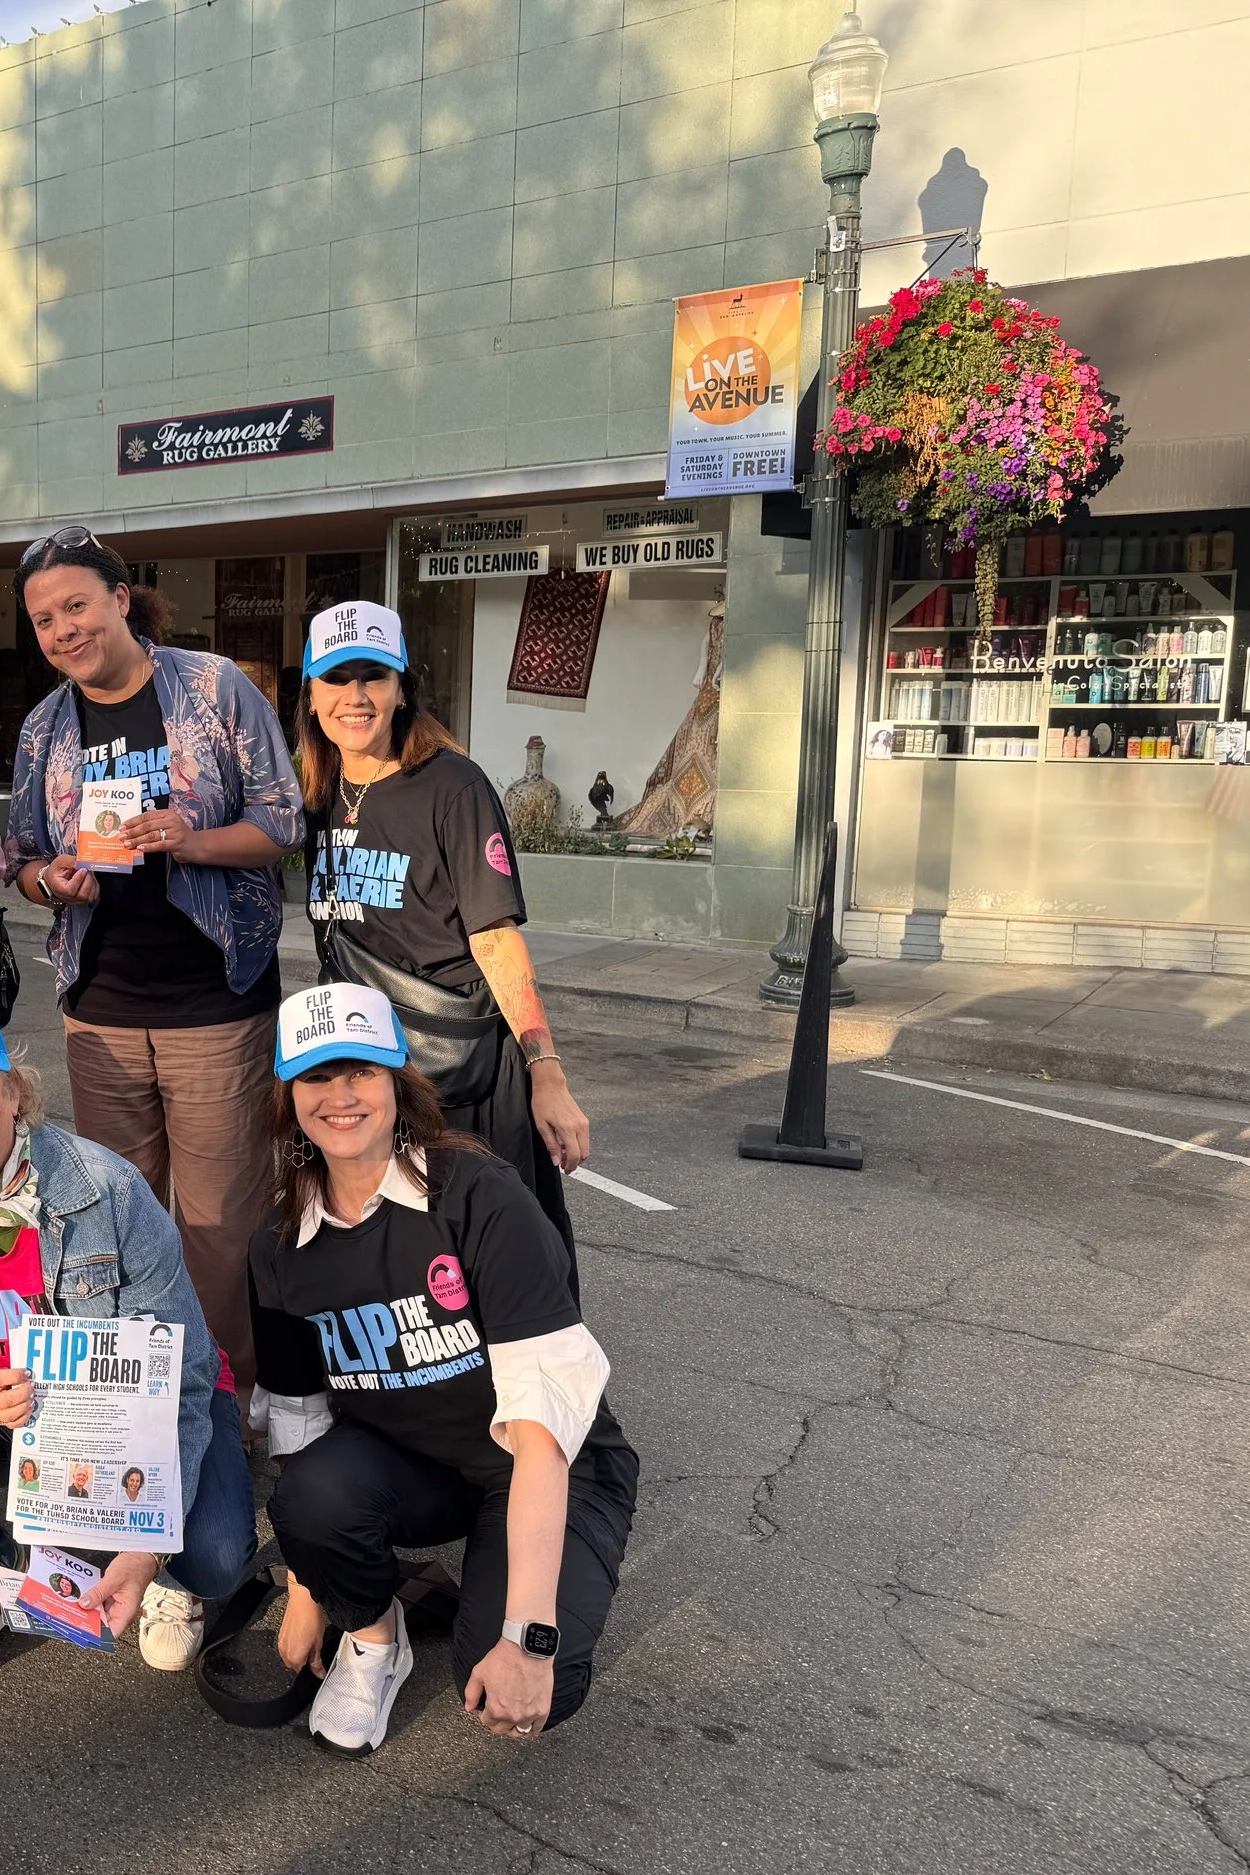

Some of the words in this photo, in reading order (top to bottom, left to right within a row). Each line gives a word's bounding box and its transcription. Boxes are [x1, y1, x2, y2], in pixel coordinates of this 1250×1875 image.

[704, 376, 731, 393] ON
[734, 375, 758, 387] THE
[688, 384, 784, 412] AVENUE
[152, 408, 293, 450] Fairmont
[162, 447, 199, 464] RUG
[202, 437, 281, 460] GALLERY
[685, 455, 716, 464] FRIDAY
[733, 449, 786, 460] DOWNTOWN
[680, 463, 724, 473] SATURDAY
[682, 471, 723, 482] EVENINGS
[732, 457, 785, 478] FREE!
[446, 518, 522, 542] HANDWASH
[584, 545, 607, 567] WE
[612, 542, 642, 565] BUY
[645, 540, 671, 562] OLD
[675, 537, 715, 559] RUGS
[428, 557, 459, 576] RUG
[464, 551, 539, 573] CLEANING
[335, 608, 357, 622] FLIP
[337, 619, 357, 632] THE
[324, 630, 358, 649] BOARD
[1113, 639, 1191, 672] Salon
[81, 744, 109, 764] OTE
[111, 737, 127, 758] IN
[89, 789, 109, 798] JOY
[111, 790, 134, 800] KOO
[310, 876, 321, 901] &
[306, 991, 332, 1010] FLIP
[309, 1006, 334, 1023] THE
[296, 1020, 335, 1045] BOARD
[432, 1282, 455, 1291] Friends
[435, 1292, 448, 1300] Tam
[28, 1317, 46, 1327] VOTE
[46, 1318, 60, 1328] OUT
[62, 1318, 75, 1329] THE
[76, 1319, 120, 1331] INCUMBENTS
[389, 1295, 434, 1332] THE
[304, 1302, 398, 1374] FLIP
[400, 1318, 481, 1368] BOARD
[26, 1329, 88, 1382] FLIP
[92, 1331, 119, 1356] THE
[89, 1357, 142, 1385] BOARD
[329, 1374, 359, 1390] VOTE
[357, 1373, 381, 1390] OUT
[379, 1372, 404, 1390] THE
[405, 1351, 485, 1387] INCUMBENTS
[53, 1383, 64, 1391] HIGH
[66, 1384, 88, 1392] SCHOOLS
[89, 1384, 99, 1392] FOR
[100, 1385, 116, 1393] EVERY
[117, 1385, 140, 1394] STUDENT.
[147, 1380, 163, 1388] LEARN
[16, 1505, 30, 1513] FOR
[32, 1507, 45, 1516] THE
[46, 1509, 69, 1520] TUHSD
[71, 1513, 99, 1523] SCHOOL
[101, 1515, 125, 1525] BOARD
[17, 1497, 34, 1507] VOTE
[35, 1501, 48, 1509] FOR
[50, 1503, 65, 1513] JOY,
[66, 1505, 87, 1515] BRIAN
[96, 1508, 125, 1518] VALERIE
[129, 1511, 154, 1526] NOV
[157, 1512, 164, 1527] 3
[39, 1546, 63, 1562] JOY
[65, 1558, 94, 1577] KOO
